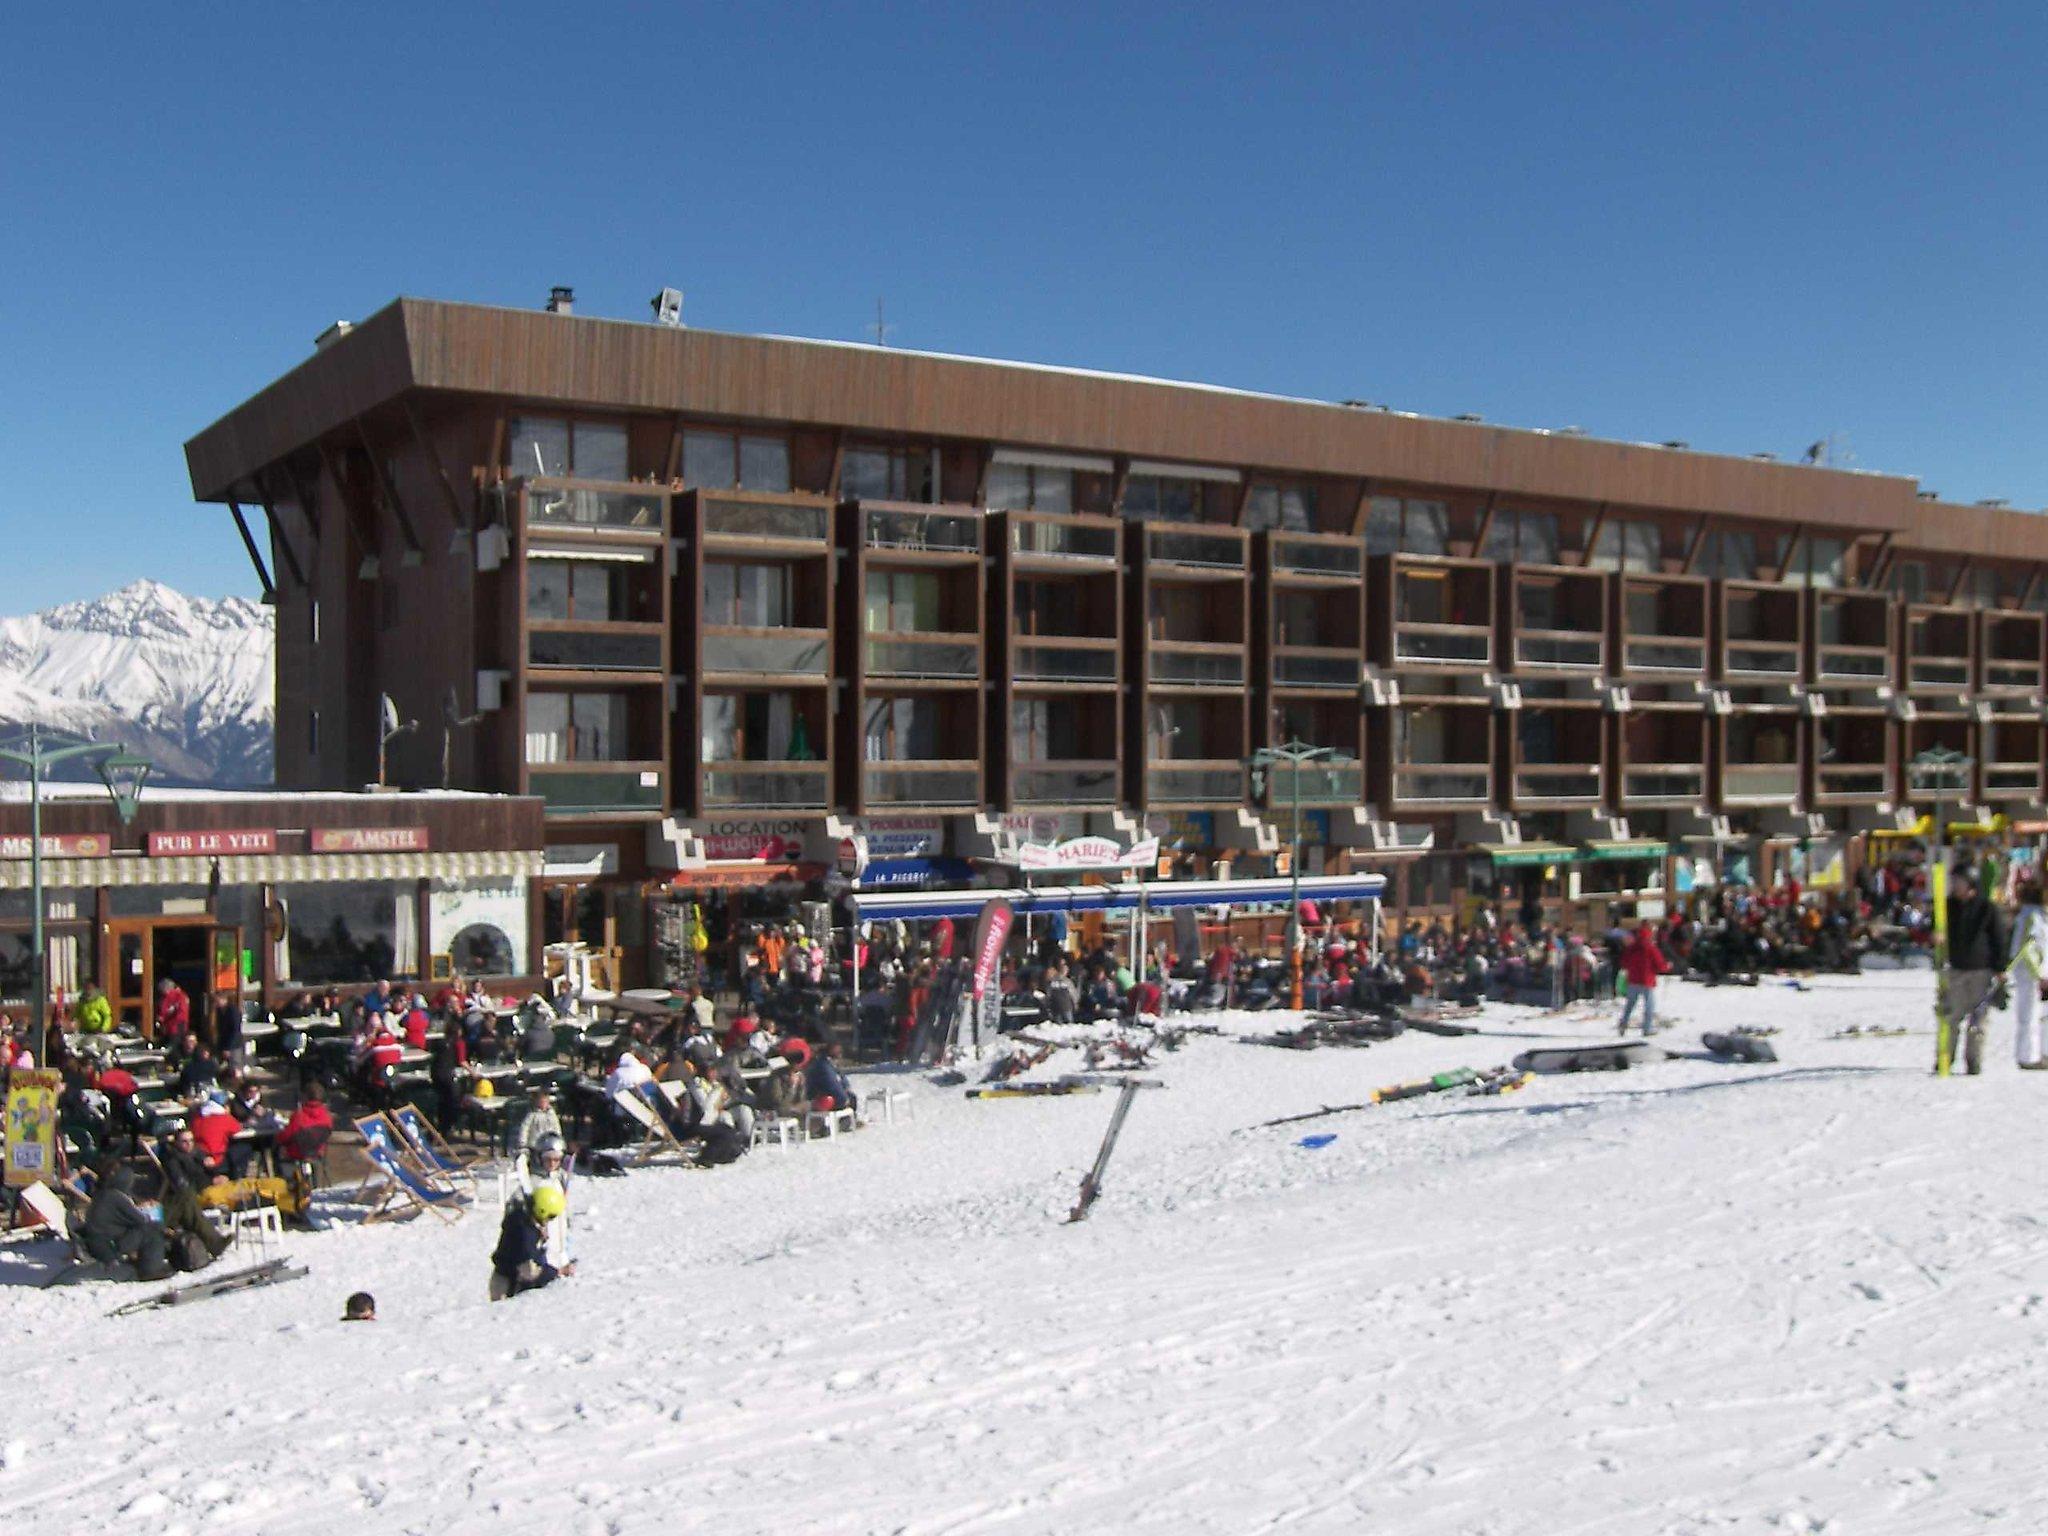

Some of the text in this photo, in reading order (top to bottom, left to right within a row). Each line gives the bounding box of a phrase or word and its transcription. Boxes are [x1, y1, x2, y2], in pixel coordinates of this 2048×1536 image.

[710, 820, 806, 836] LOCATION
[156, 833, 269, 851] PUB LE YETI
[351, 830, 417, 849] AMSTEL
[1056, 843, 1120, 863] MARIE'S
